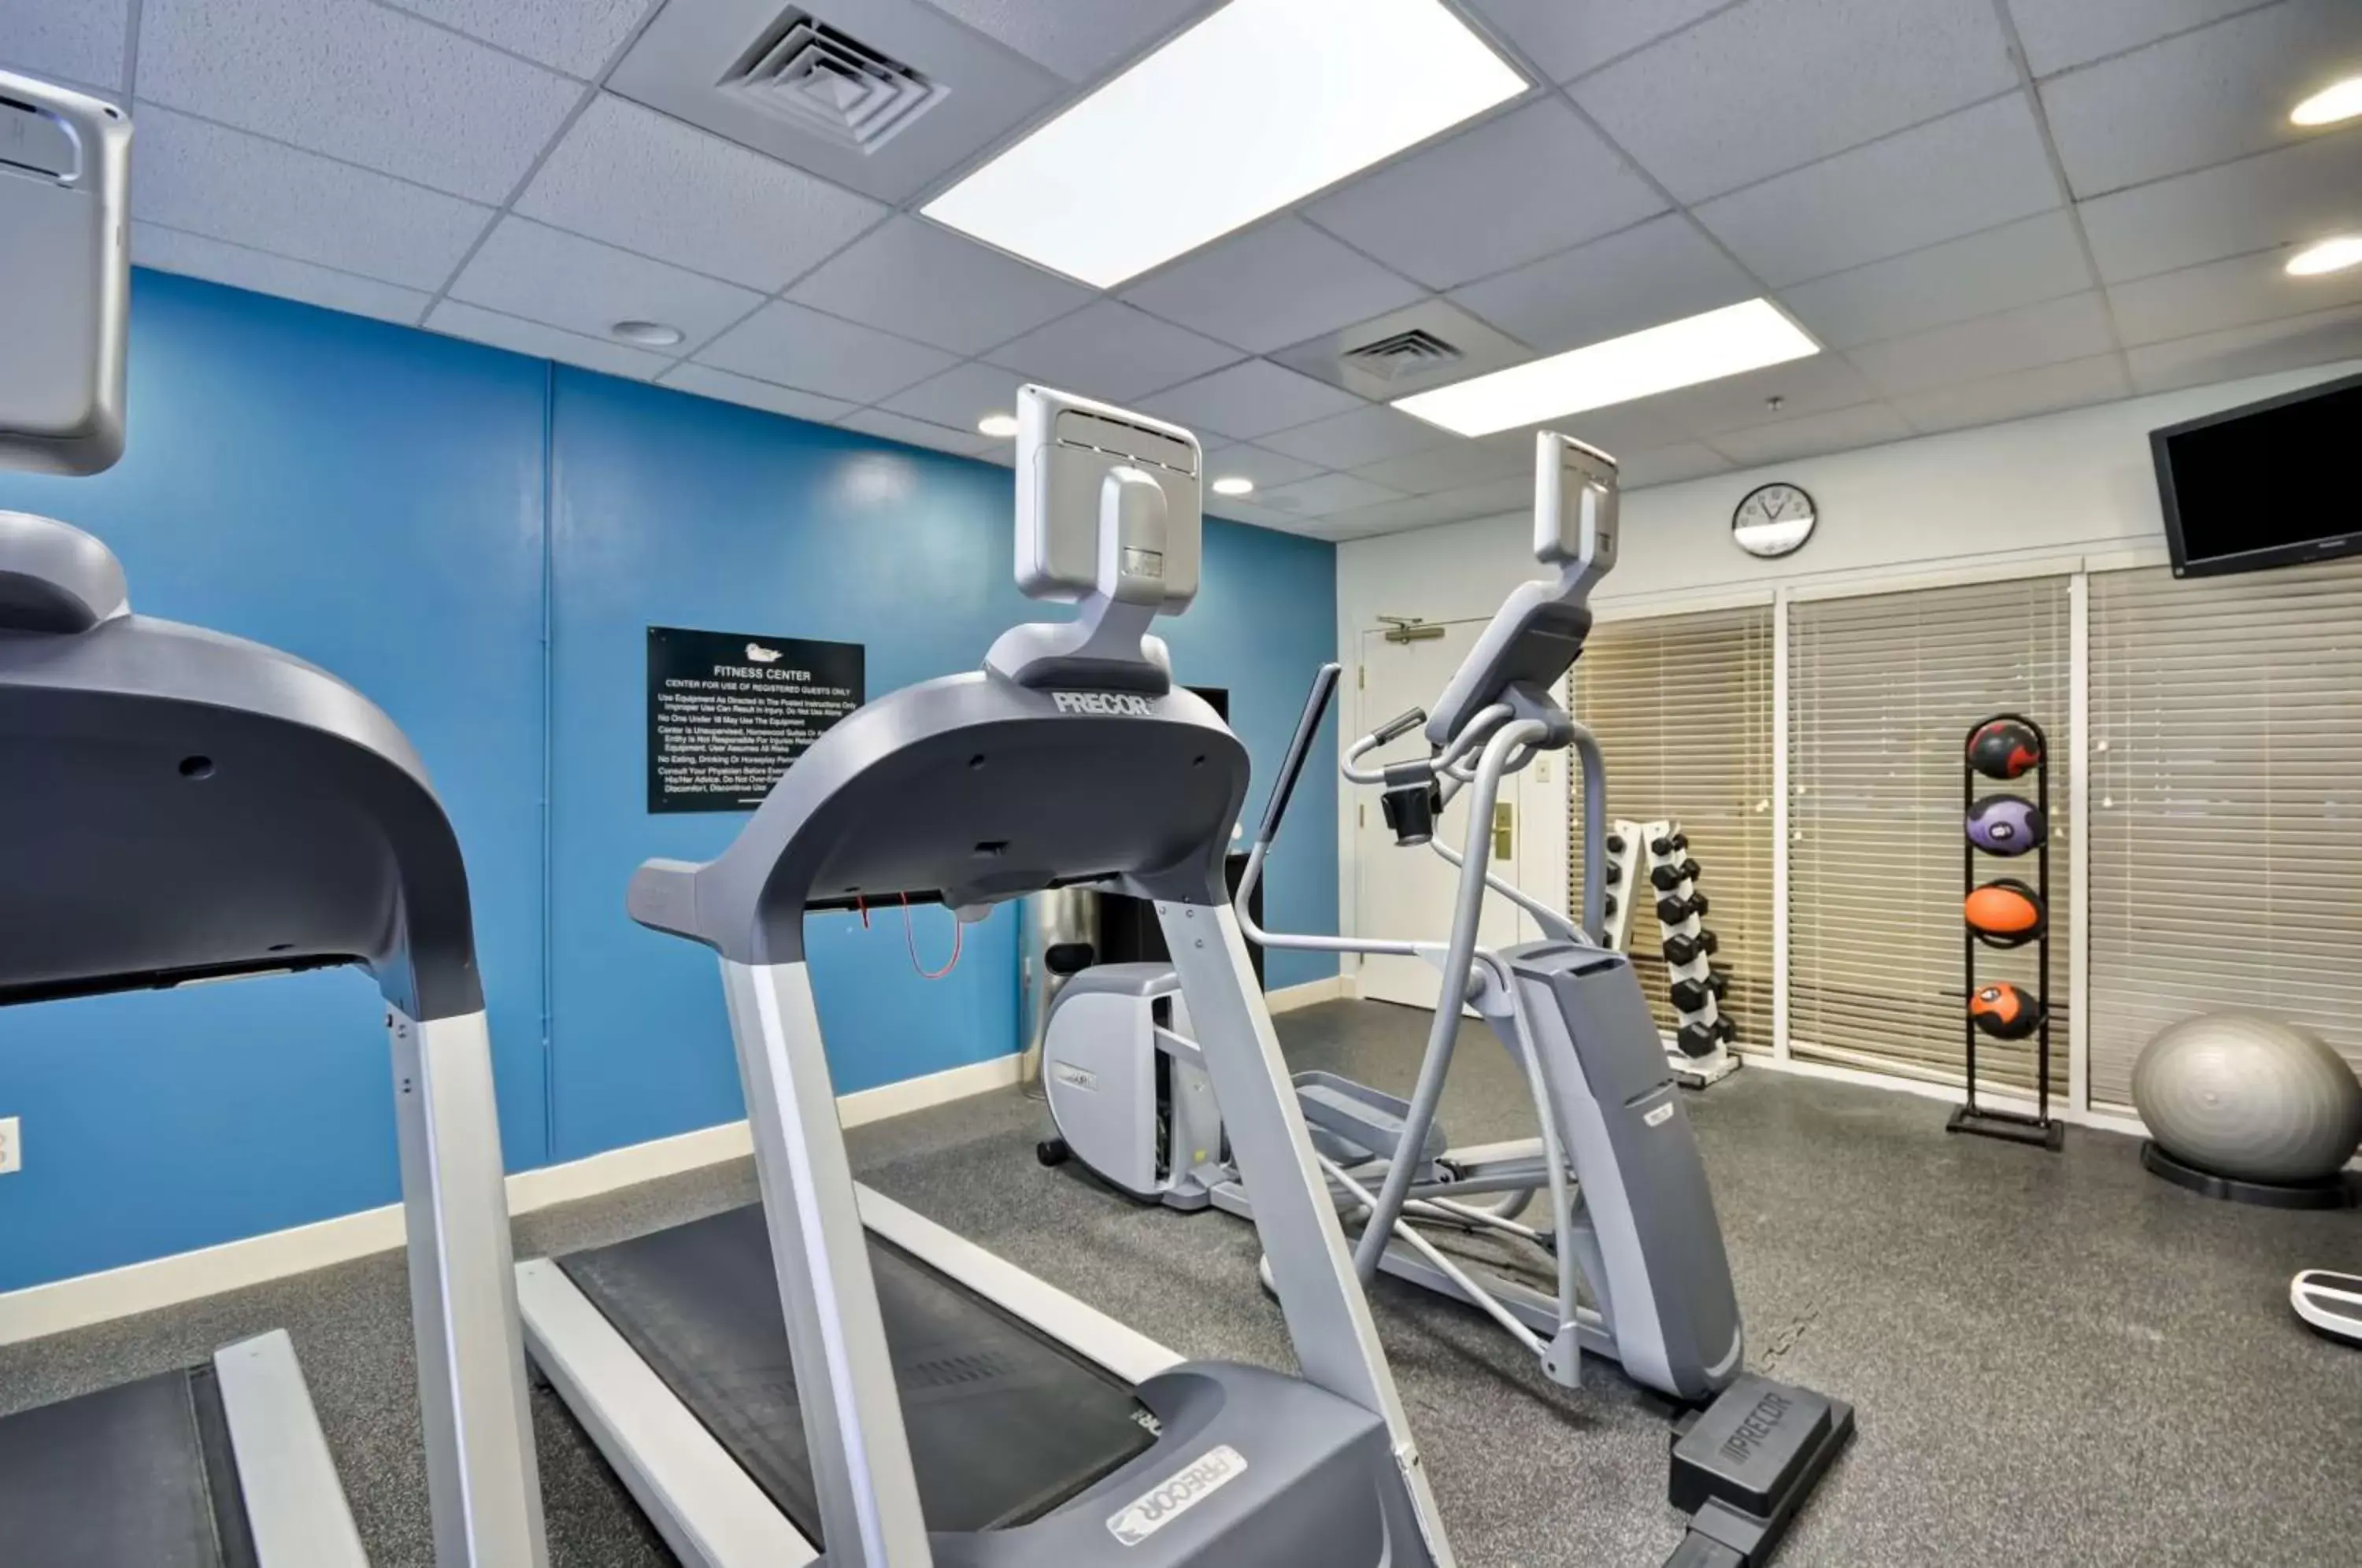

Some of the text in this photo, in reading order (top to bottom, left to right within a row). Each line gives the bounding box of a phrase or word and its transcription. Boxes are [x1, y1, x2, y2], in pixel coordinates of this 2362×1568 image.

[714, 665, 811, 681] FITNESS CENTER
[665, 679, 701, 688] CENTER
[702, 680, 720, 689] FOR
[720, 682, 738, 690] USE
[752, 684, 801, 693] REGISTERED
[802, 686, 830, 695] GUESTS
[831, 687, 851, 696] ONLY
[657, 693, 674, 701] Use
[675, 693, 716, 704] Equipment
[716, 695, 727, 704] As
[727, 696, 757, 704] Directed
[1052, 692, 1150, 715] PRECOR
[664, 702, 699, 712] Improper
[732, 704, 755, 713] Result
[657, 713, 669, 722] No
[671, 714, 687, 723] One
[688, 715, 712, 723] Under
[722, 716, 739, 725] May
[665, 734, 687, 744] Entity
[711, 735, 755, 745] Responsible
[698, 756, 729, 765] Drinking
[741, 756, 776, 764] Horseplay
[657, 766, 687, 775] Consult
[708, 767, 742, 776] Physician
[1727, 1392, 1794, 1456] PRECOR
[1137, 1455, 1231, 1521] PRECOR
